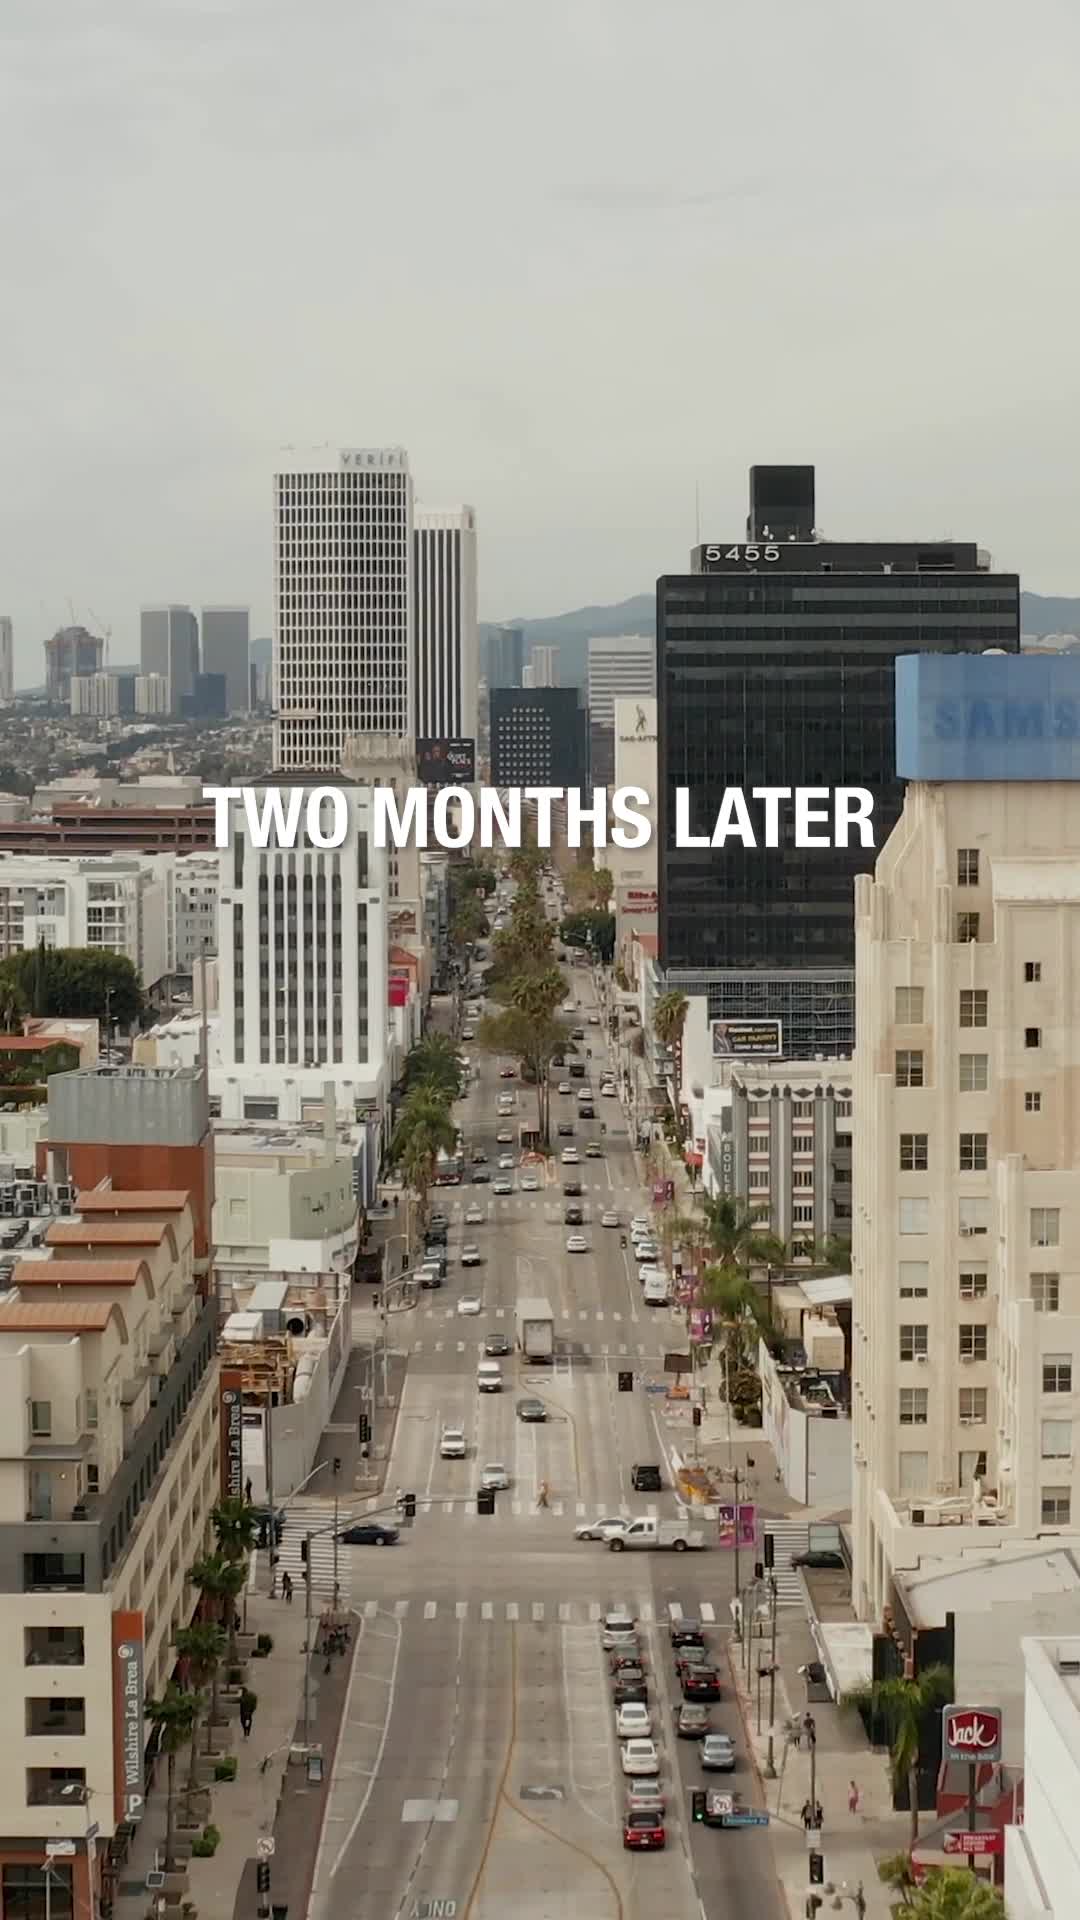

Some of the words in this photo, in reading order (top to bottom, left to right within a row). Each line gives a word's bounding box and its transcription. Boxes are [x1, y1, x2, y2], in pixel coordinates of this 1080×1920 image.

[705, 545, 780, 561] 5455
[228, 1404, 241, 1437] Brea
[228, 1441, 241, 1457] La
[227, 1460, 241, 1499] lshire
[125, 1660, 138, 1695] Brea
[125, 1699, 138, 1715] La
[948, 1715, 997, 1747] Jack
[125, 1722, 139, 1786] Wilshire
[128, 1794, 143, 1813] P
